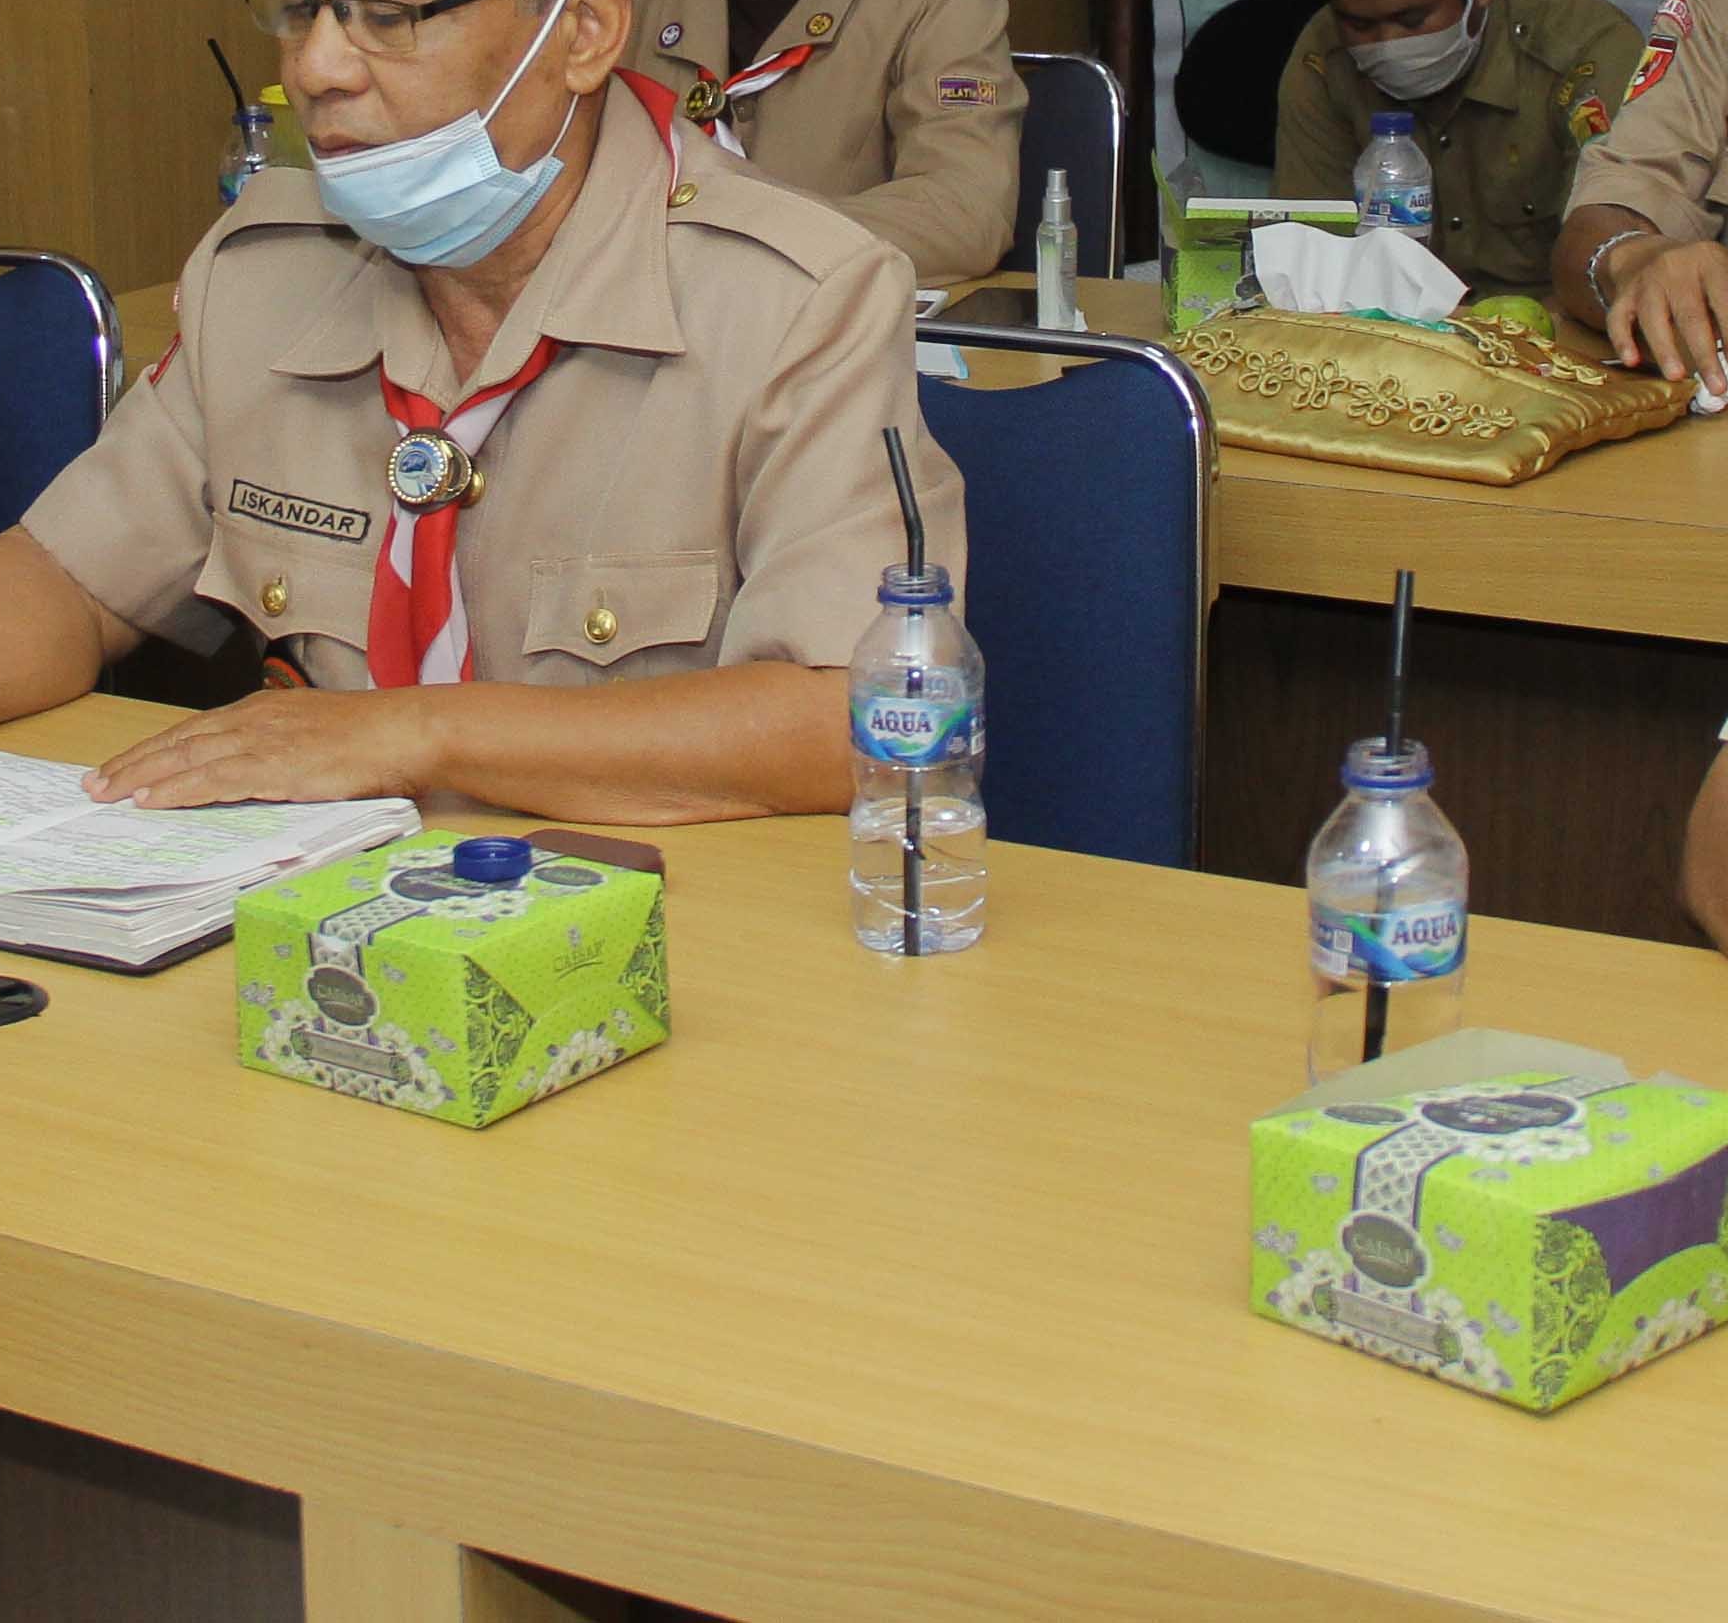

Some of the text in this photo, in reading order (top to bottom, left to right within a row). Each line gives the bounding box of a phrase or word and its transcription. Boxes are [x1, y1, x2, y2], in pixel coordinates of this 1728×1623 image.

[240, 488, 356, 534] ISKANDAR
[871, 708, 933, 737] AQUA
[1391, 912, 1458, 947] AQUA
